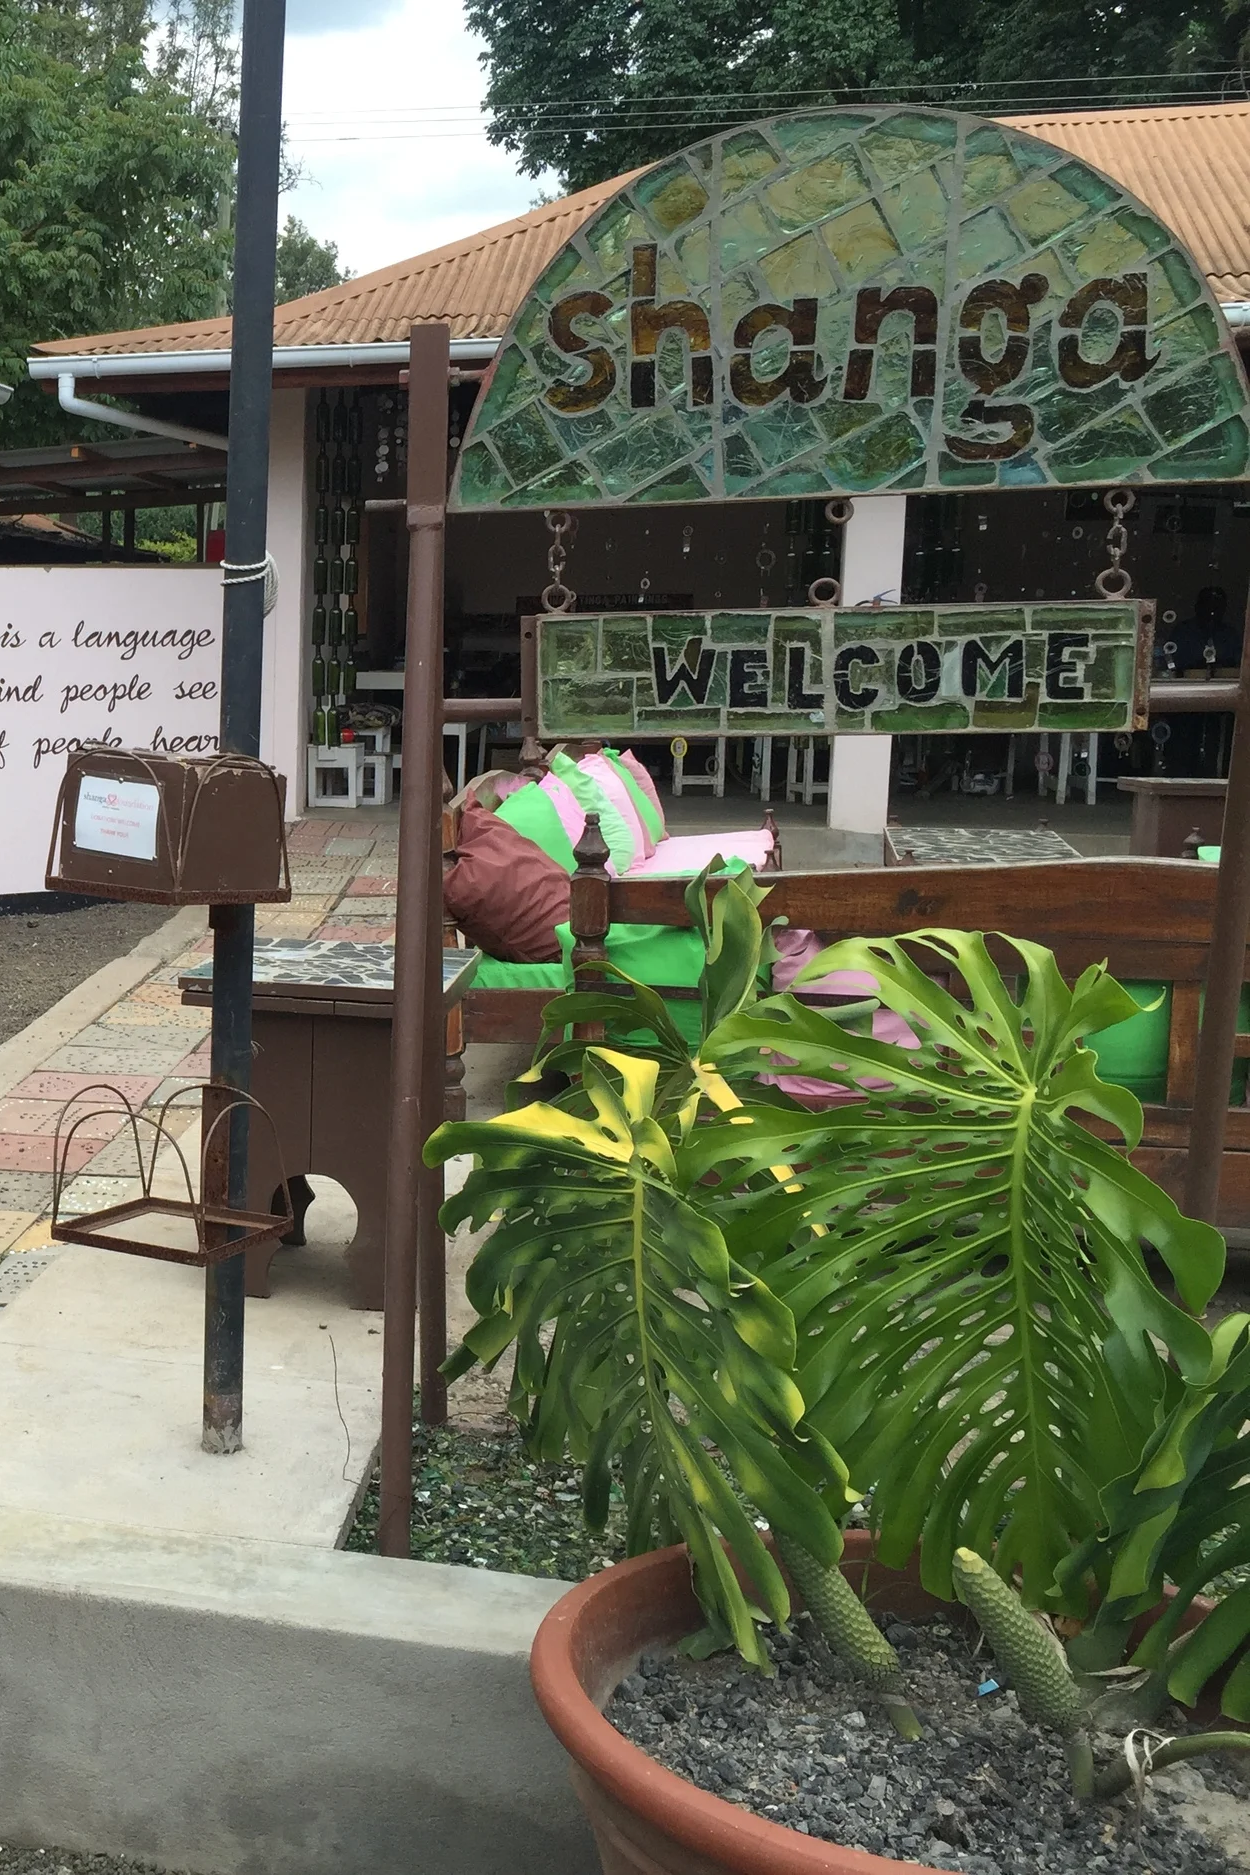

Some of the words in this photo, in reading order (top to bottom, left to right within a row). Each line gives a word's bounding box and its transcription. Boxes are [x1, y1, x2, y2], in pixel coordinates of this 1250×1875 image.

[546, 243, 1162, 461] shanga
[0, 623, 27, 649] is
[39, 631, 62, 649] a
[71, 620, 216, 661] language
[651, 632, 1093, 709] WELCOME
[60, 673, 153, 714] people
[173, 680, 218, 700] see
[32, 726, 123, 769] peole
[149, 725, 220, 753] hear
